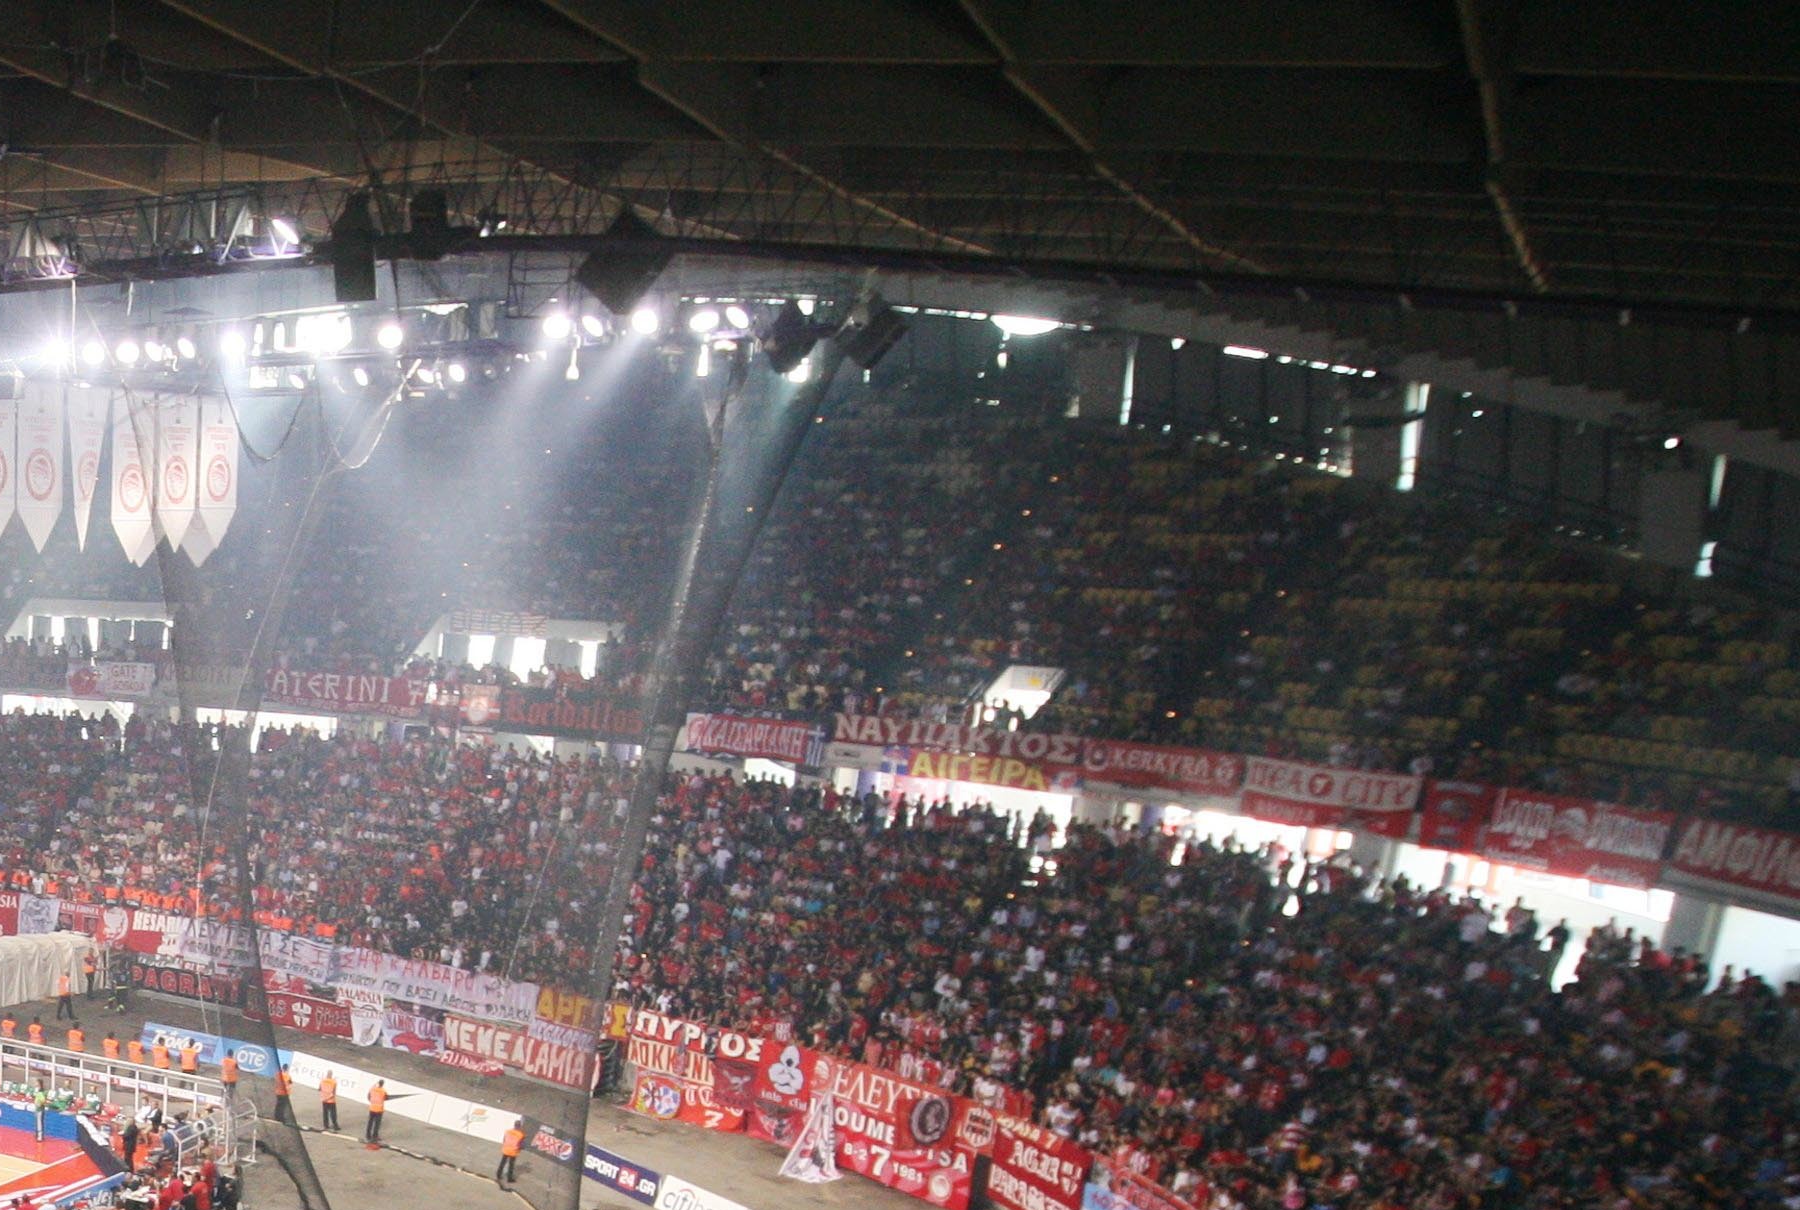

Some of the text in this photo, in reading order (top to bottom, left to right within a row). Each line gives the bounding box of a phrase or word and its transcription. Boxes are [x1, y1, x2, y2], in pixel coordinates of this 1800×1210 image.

[835, 713, 1077, 763] ΝΑΥΠΑΚΤΟΣ
[910, 752, 1048, 792] ΑΙΓΕΙΡΑ
[238, 1050, 266, 1067] OTE
[444, 1018, 525, 1067] NEMEA
[525, 1036, 586, 1086] LAMIA
[584, 1153, 620, 1180] SPORT
[620, 1168, 635, 1188] 24
[870, 1145, 891, 1177] 7
